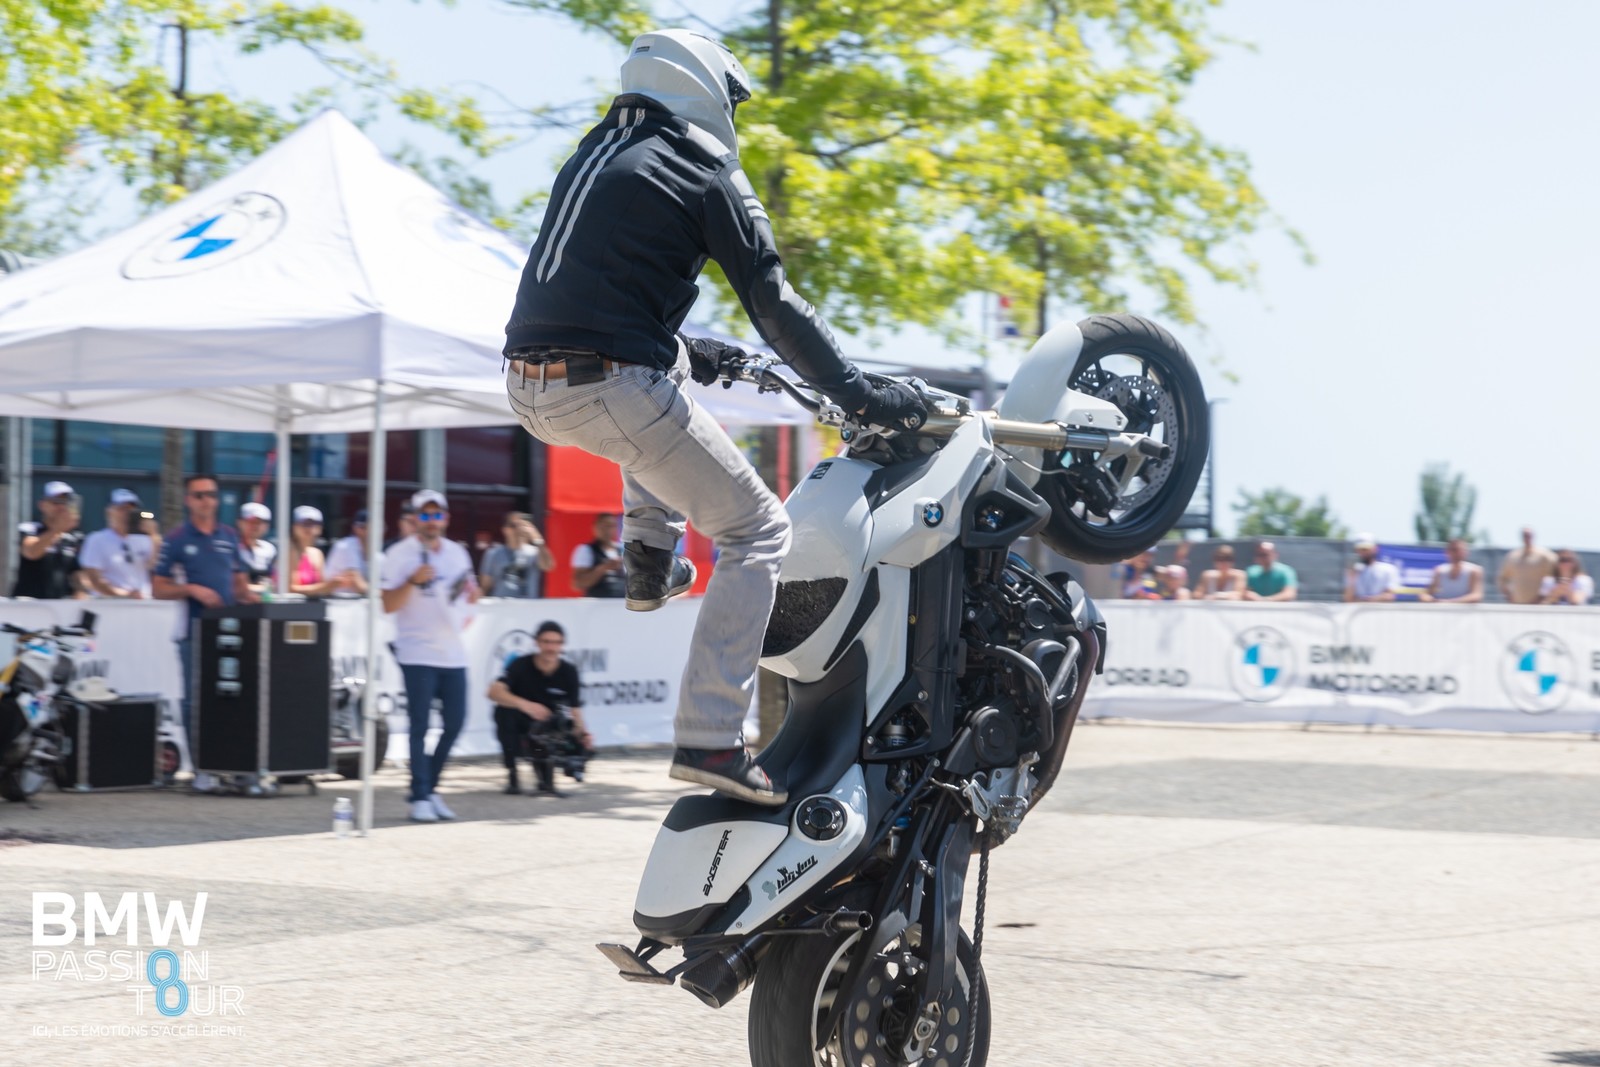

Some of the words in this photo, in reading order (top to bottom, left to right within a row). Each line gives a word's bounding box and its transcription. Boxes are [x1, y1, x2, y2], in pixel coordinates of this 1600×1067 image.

[1309, 645, 1374, 664] BMW
[1103, 667, 1191, 688] ORRAD
[1308, 673, 1459, 695] MOTORRAD
[703, 829, 732, 897] BAGSTER
